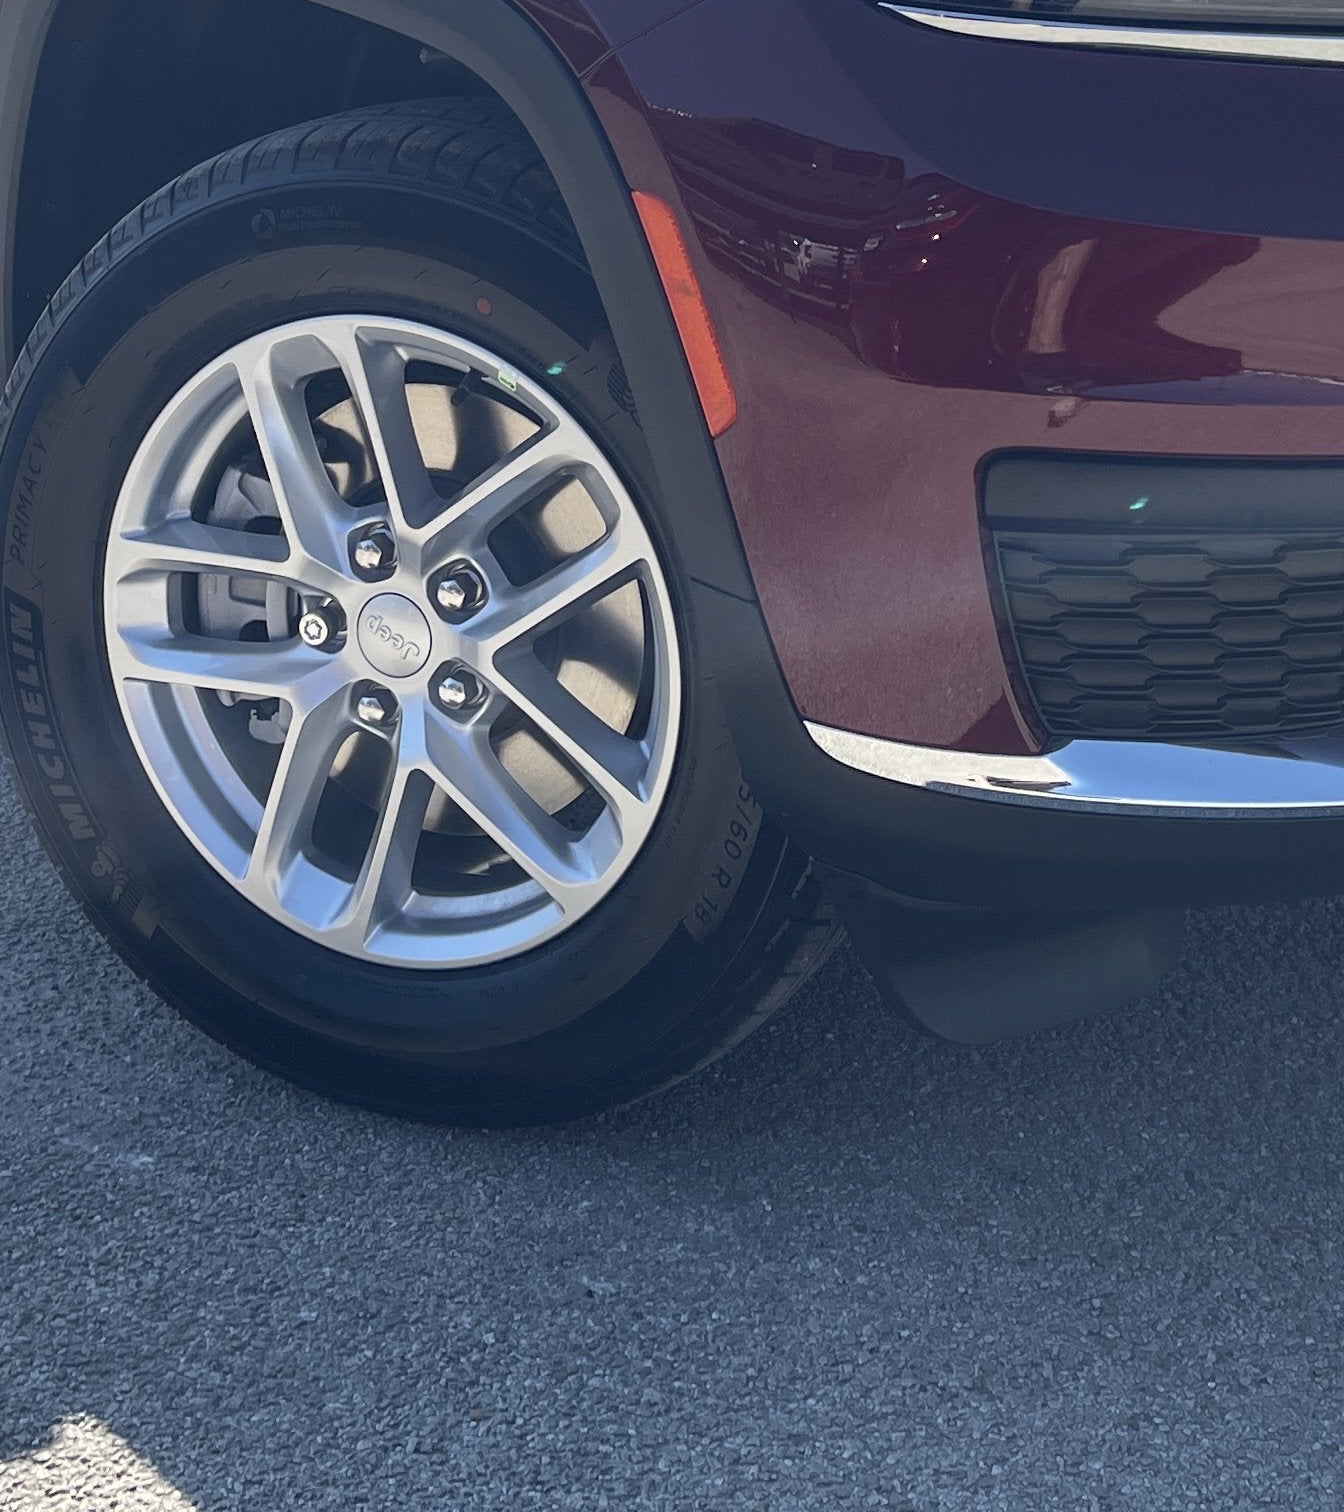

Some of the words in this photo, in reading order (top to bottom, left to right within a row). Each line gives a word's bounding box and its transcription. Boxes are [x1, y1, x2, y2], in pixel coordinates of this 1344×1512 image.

[10, 435, 48, 565] PRIMACY
[366, 614, 421, 661] Jeep
[8, 601, 97, 842] MICHELIN
[711, 864, 732, 890] R
